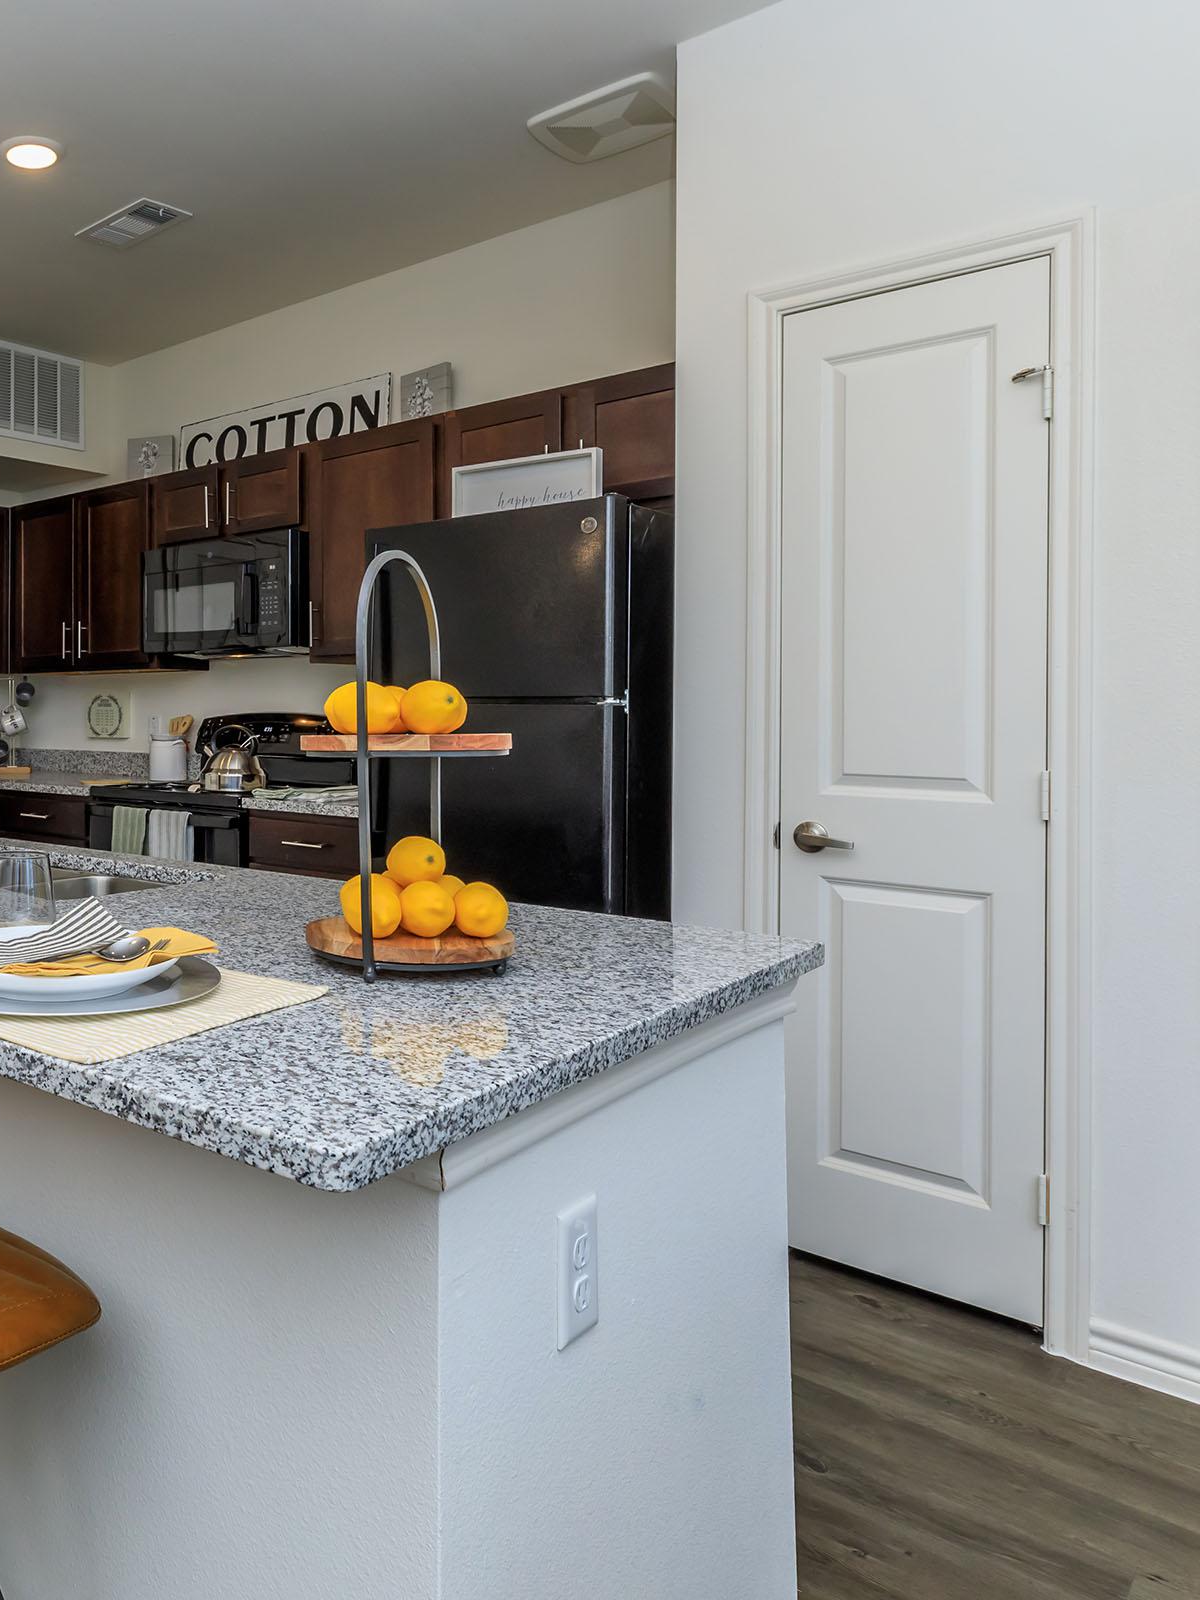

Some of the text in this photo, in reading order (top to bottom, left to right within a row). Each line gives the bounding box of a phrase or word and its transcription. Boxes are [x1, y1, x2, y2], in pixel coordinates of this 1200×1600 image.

[185, 389, 381, 469] COTTON
[497, 486, 584, 509] happy house
